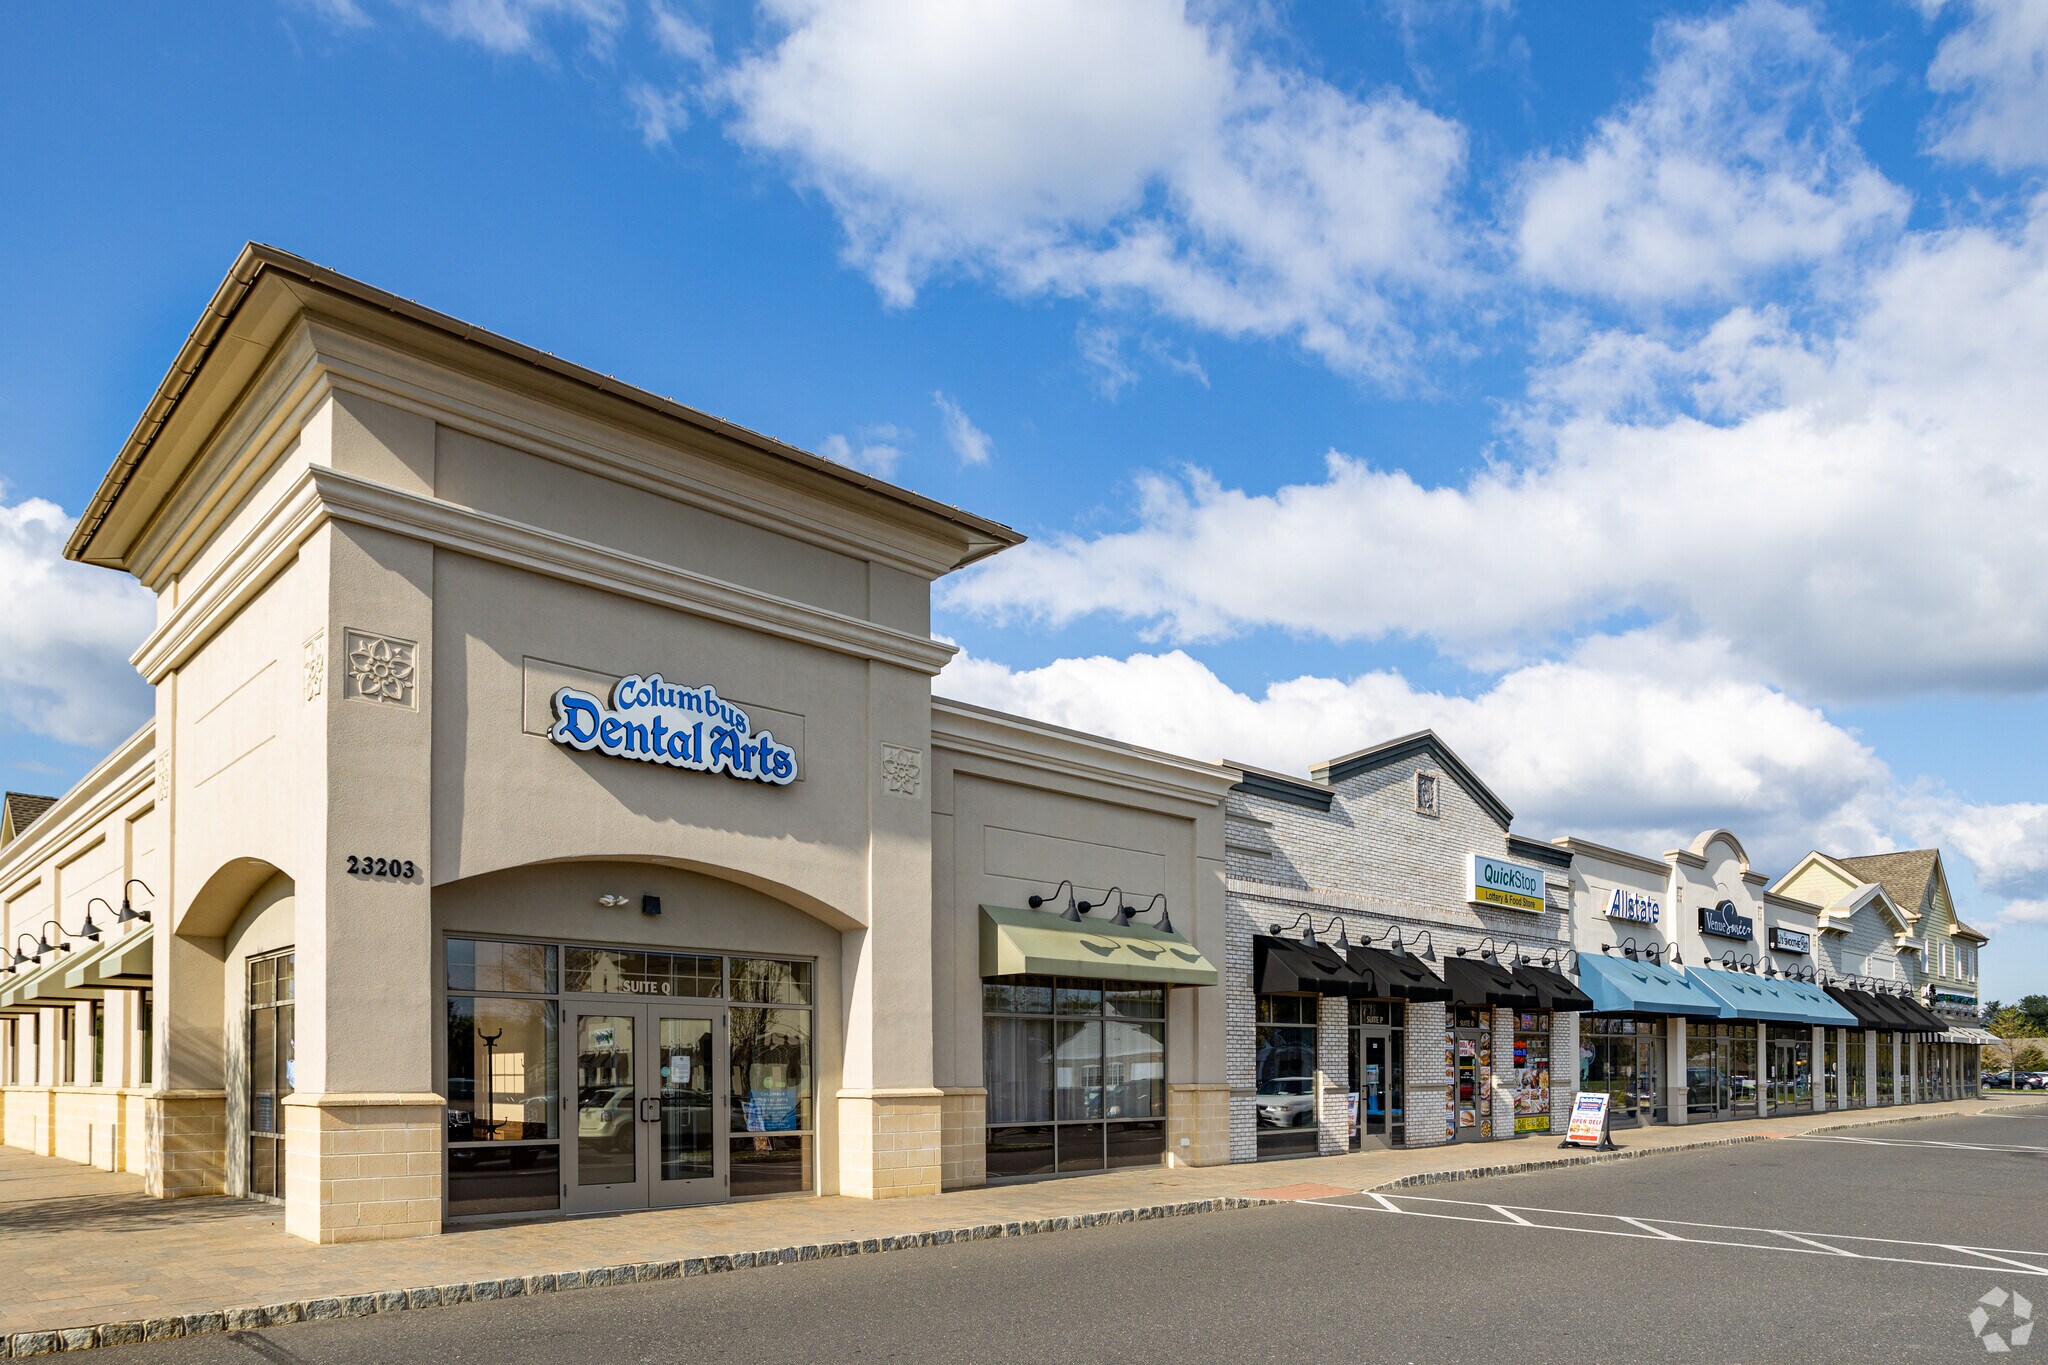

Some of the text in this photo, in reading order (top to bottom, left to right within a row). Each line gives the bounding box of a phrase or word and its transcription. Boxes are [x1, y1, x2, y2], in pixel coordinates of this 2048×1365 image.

[618, 679, 746, 734] Columbus
[560, 694, 793, 778] Dental Arts
[346, 855, 415, 879] 23203
[1484, 863, 1537, 896] QuickStop
[1485, 890, 1536, 909] Lottery & Food Store
[1610, 889, 1660, 924] Allstate
[1706, 912, 1726, 933] Venue
[622, 980, 671, 996] SUITE Q
[1366, 1015, 1384, 1024] SUITE P
[1459, 1019, 1471, 1027] SUITE
